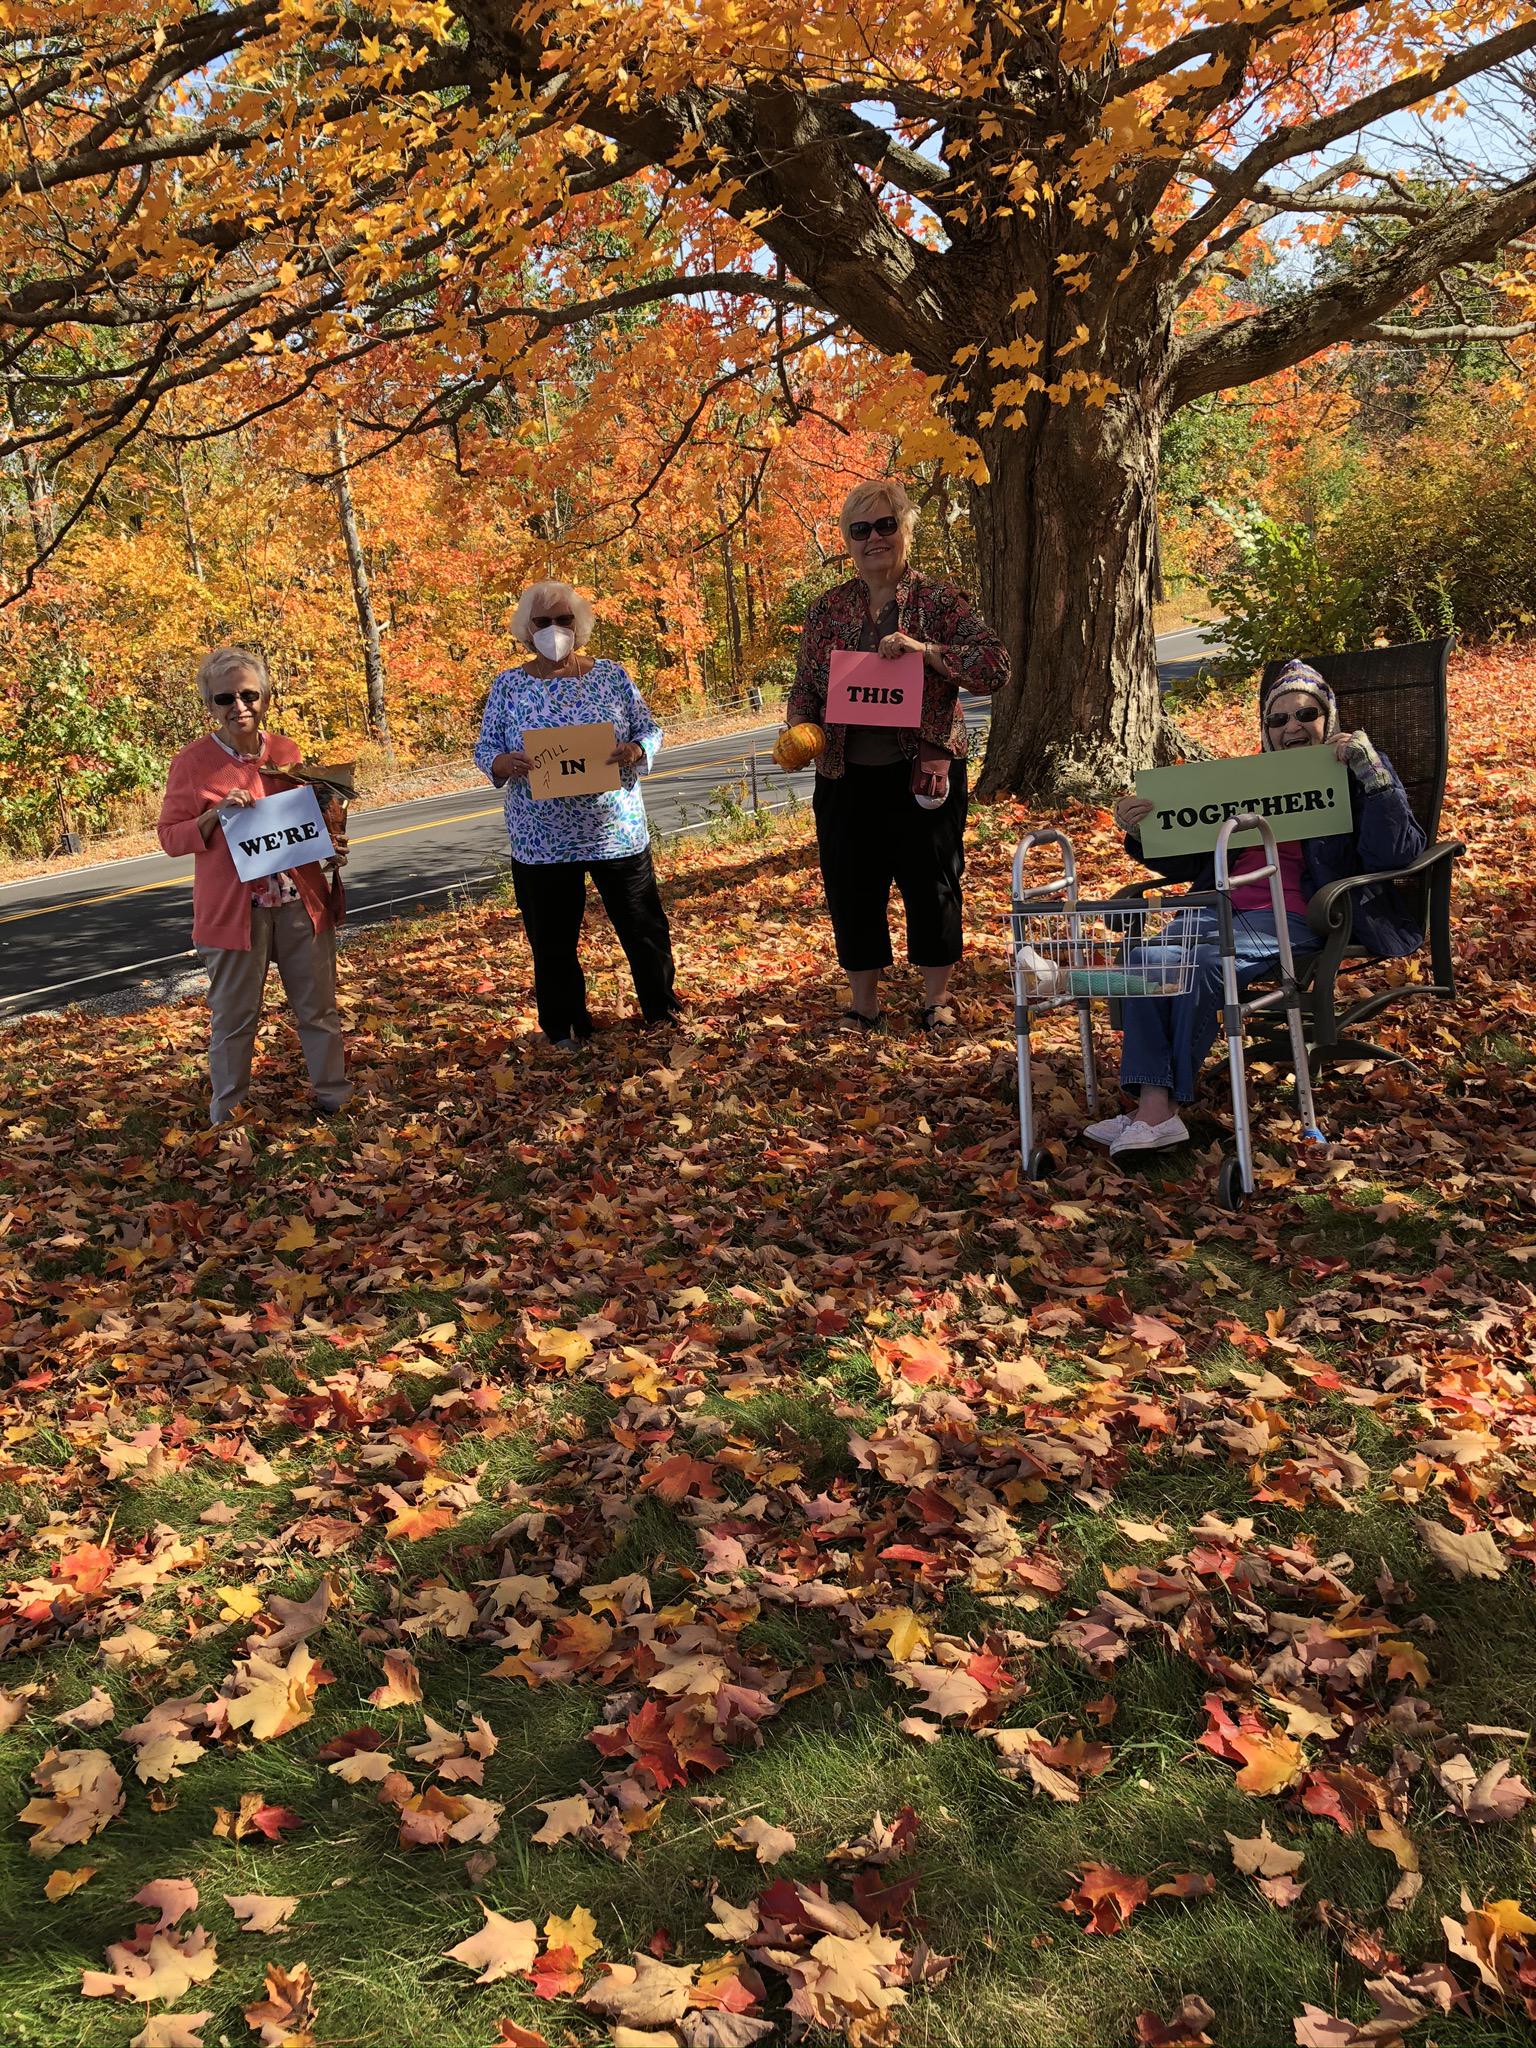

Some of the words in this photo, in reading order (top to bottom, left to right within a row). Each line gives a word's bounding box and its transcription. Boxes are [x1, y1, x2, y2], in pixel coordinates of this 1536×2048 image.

[847, 686, 904, 705] THIS
[534, 744, 569, 769] STILL
[560, 758, 586, 776] IN
[1156, 787, 1336, 831] TOGETHER!
[238, 821, 319, 857] WE'RE
